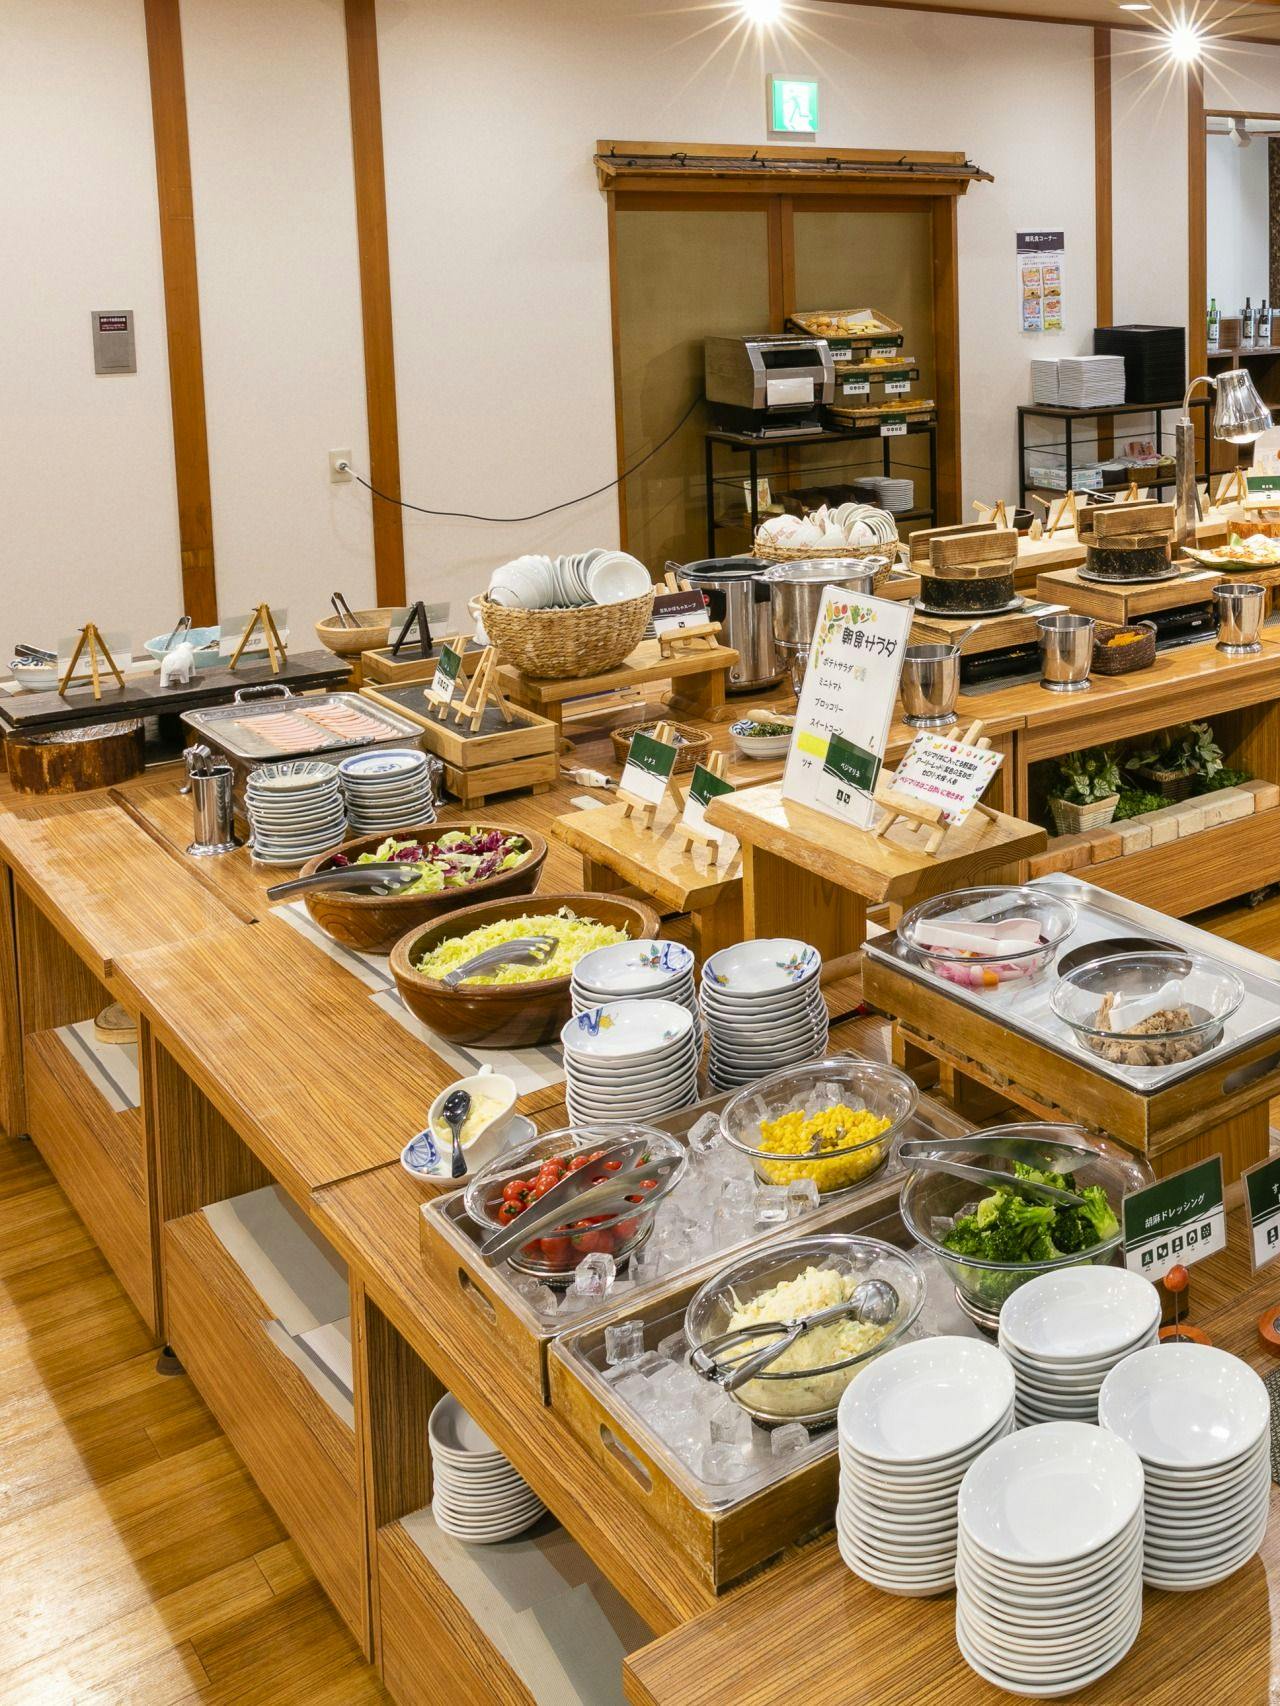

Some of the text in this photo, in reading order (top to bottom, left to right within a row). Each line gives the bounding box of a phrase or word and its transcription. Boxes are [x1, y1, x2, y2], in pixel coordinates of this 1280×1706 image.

[842, 626, 897, 658] 朝食サラダ
[823, 657, 854, 674] ポテトサラダ
[819, 677, 842, 692] ミニトマト
[814, 697, 844, 713] ブロッコリー
[809, 717, 845, 737] スイートコーン
[802, 758, 813, 769] ツナ
[840, 762, 862, 778] ベジマリネ
[1145, 1192, 1206, 1229] 胡麻ドレッシング
